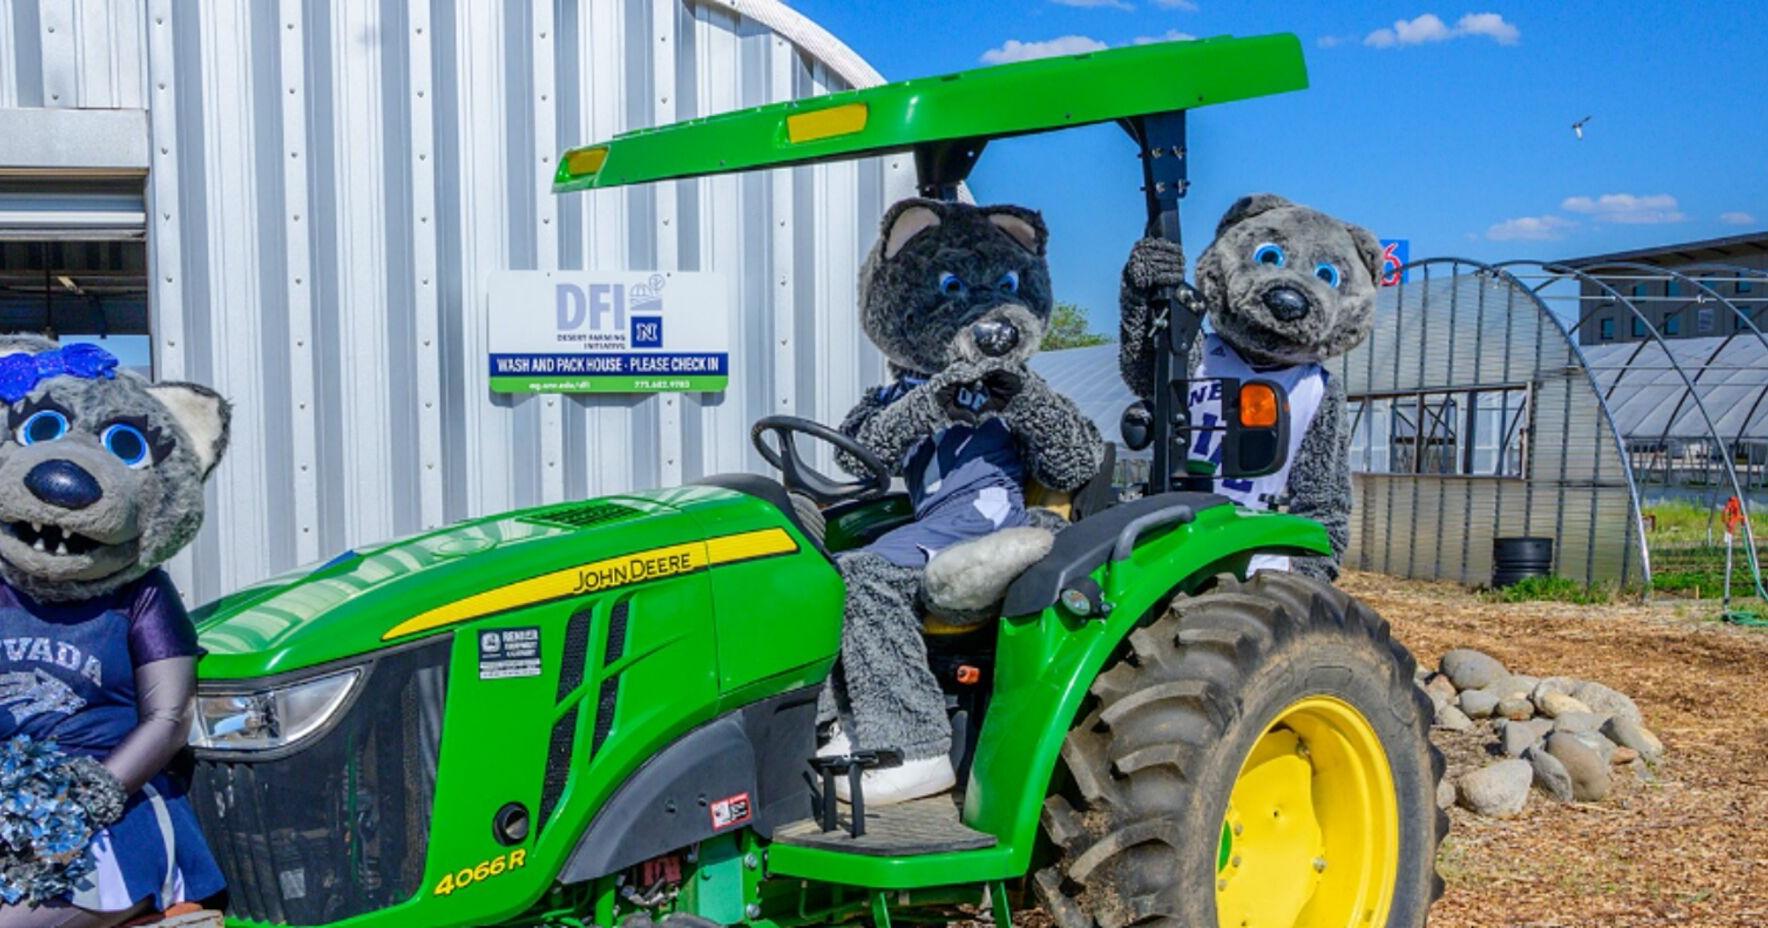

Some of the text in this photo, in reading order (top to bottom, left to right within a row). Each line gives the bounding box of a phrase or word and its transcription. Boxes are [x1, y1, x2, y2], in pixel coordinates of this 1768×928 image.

[556, 284, 625, 330] DFI
[557, 334, 586, 342] DESERT
[636, 323, 658, 342] N
[496, 356, 719, 373] WASH AND PACK HOUSE PLEASE CHECK IN
[573, 553, 691, 592] JOHN DEERE
[0, 637, 102, 688] VADA
